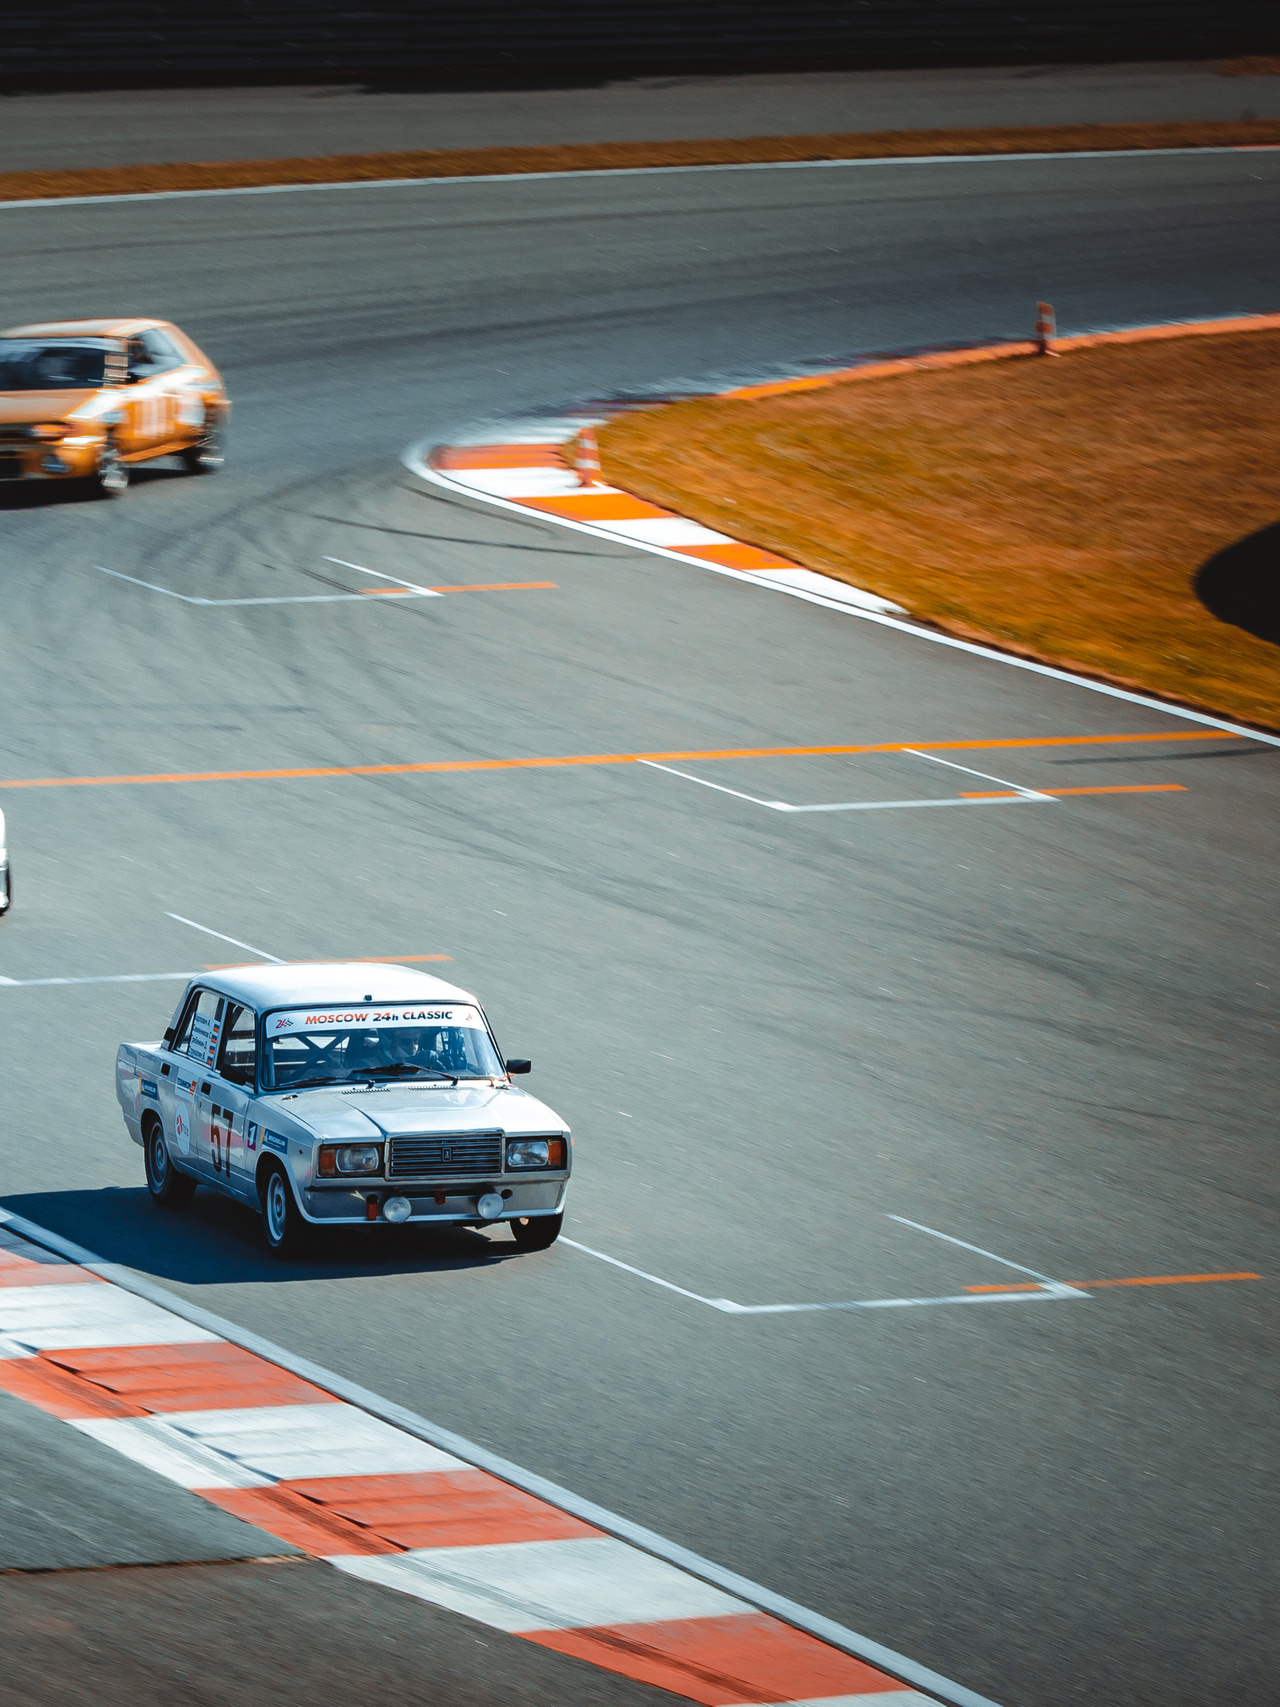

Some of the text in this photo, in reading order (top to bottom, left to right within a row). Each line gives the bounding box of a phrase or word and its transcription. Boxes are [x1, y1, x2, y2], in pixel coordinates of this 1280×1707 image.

[305, 1010, 453, 1025] MOSCOW 24h CLASSIC
[210, 1103, 234, 1178] 57
